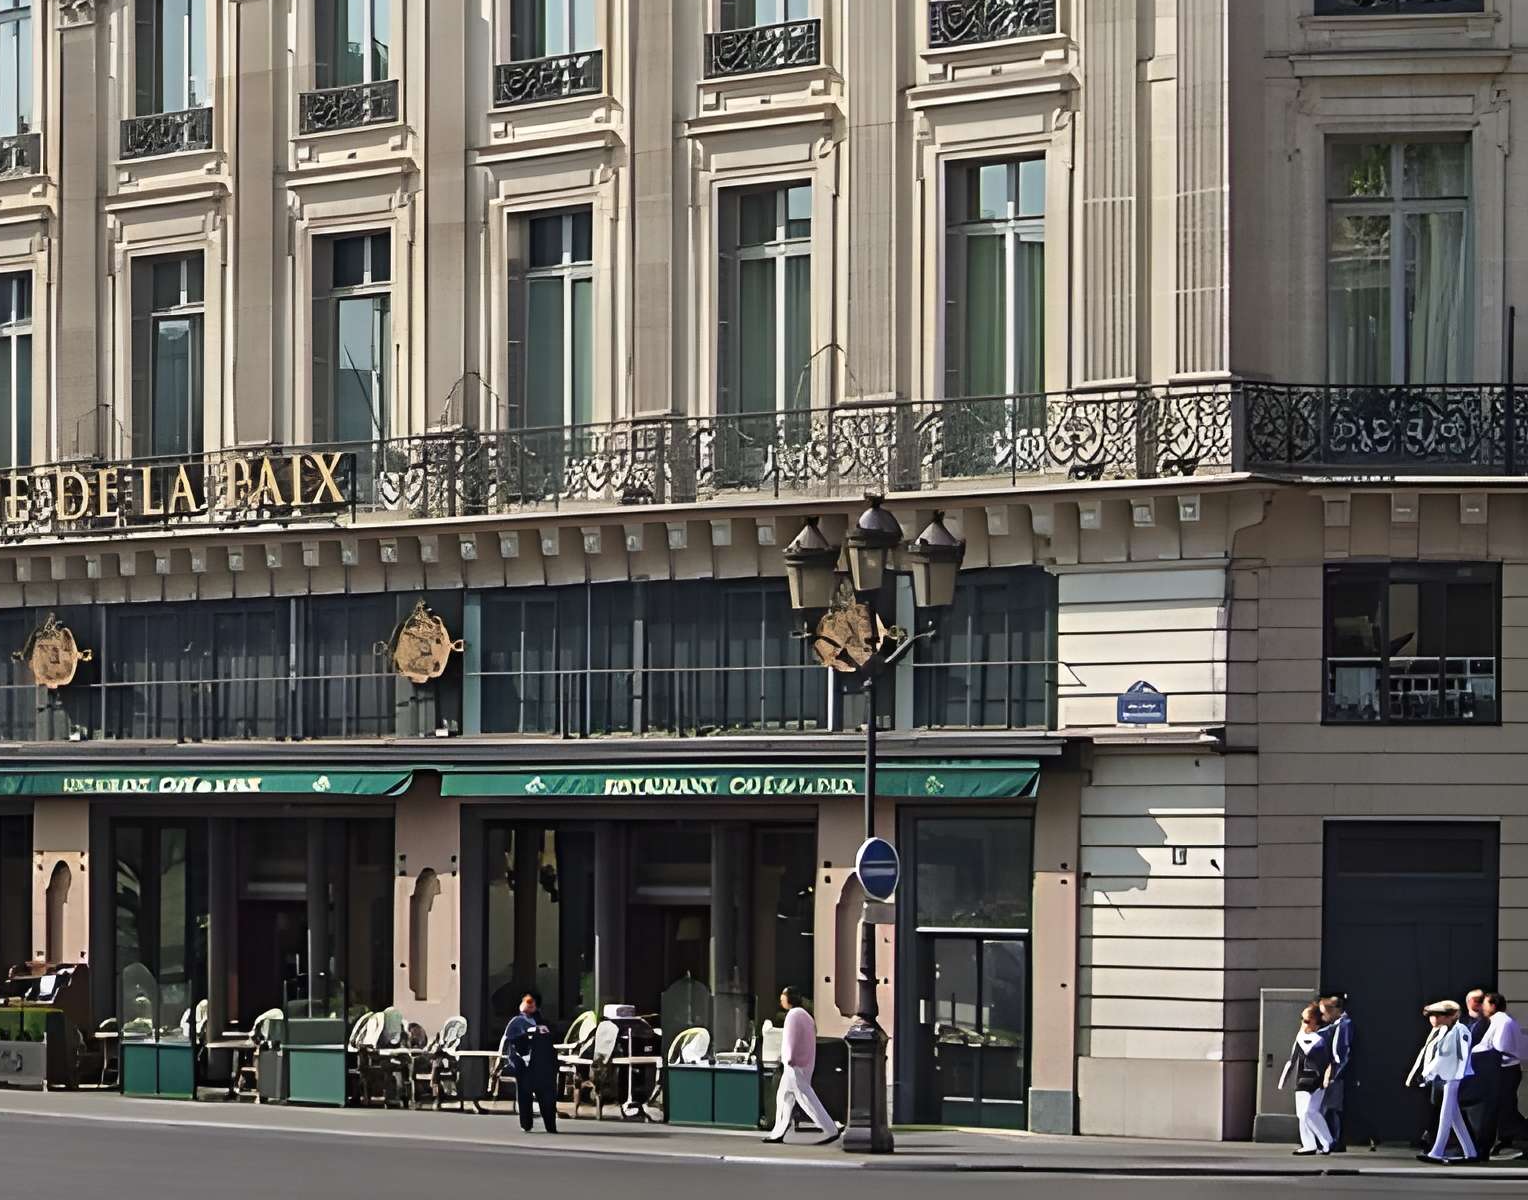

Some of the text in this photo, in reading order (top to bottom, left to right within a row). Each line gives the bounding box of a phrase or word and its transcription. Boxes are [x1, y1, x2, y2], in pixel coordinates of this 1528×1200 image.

[56, 467, 118, 521] DE
[143, 464, 201, 515] LA
[225, 452, 345, 509] PAIX
